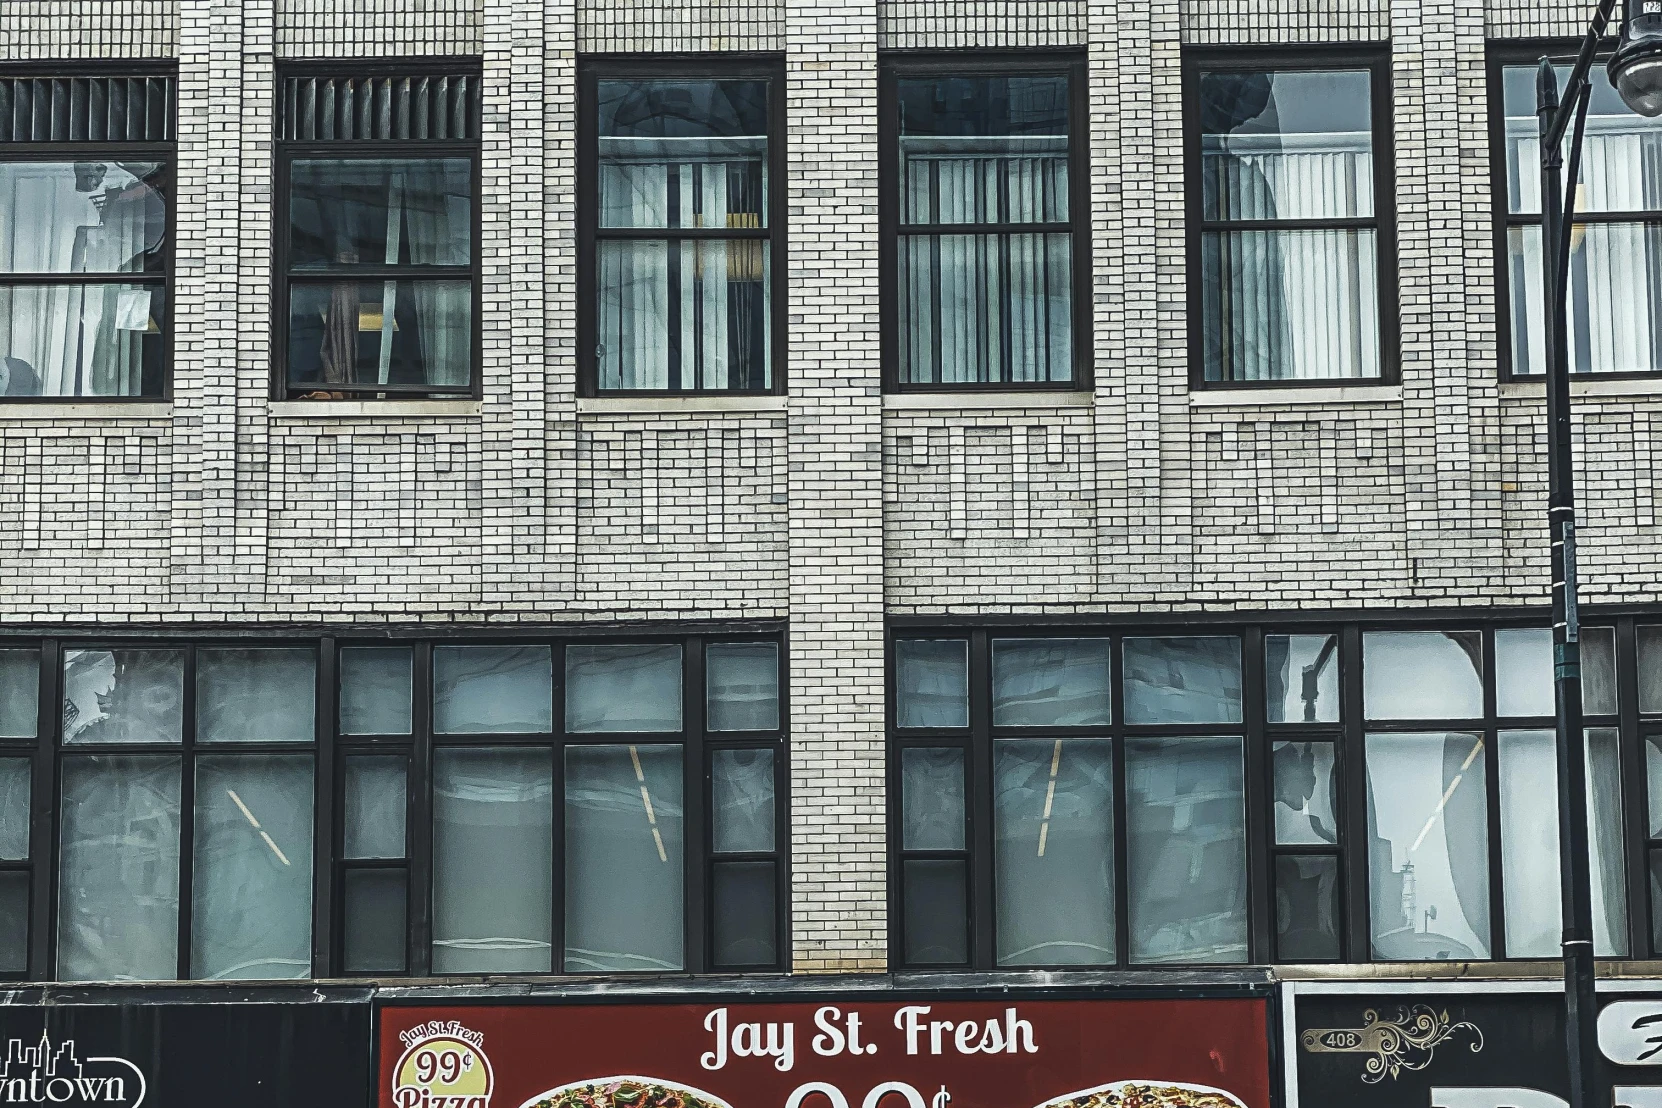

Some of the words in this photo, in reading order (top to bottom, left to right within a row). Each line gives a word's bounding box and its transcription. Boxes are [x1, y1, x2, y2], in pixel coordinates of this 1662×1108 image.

[400, 1023, 428, 1048] Jay
[428, 1021, 447, 1036] St.
[447, 1021, 484, 1047] Fresh
[700, 1007, 795, 1071] Jay
[812, 1006, 878, 1057] St.
[894, 1006, 1039, 1056] Fresh
[1326, 1033, 1356, 1048] 408
[416, 1050, 472, 1084] 99¢
[0, 1069, 126, 1102] ntown
